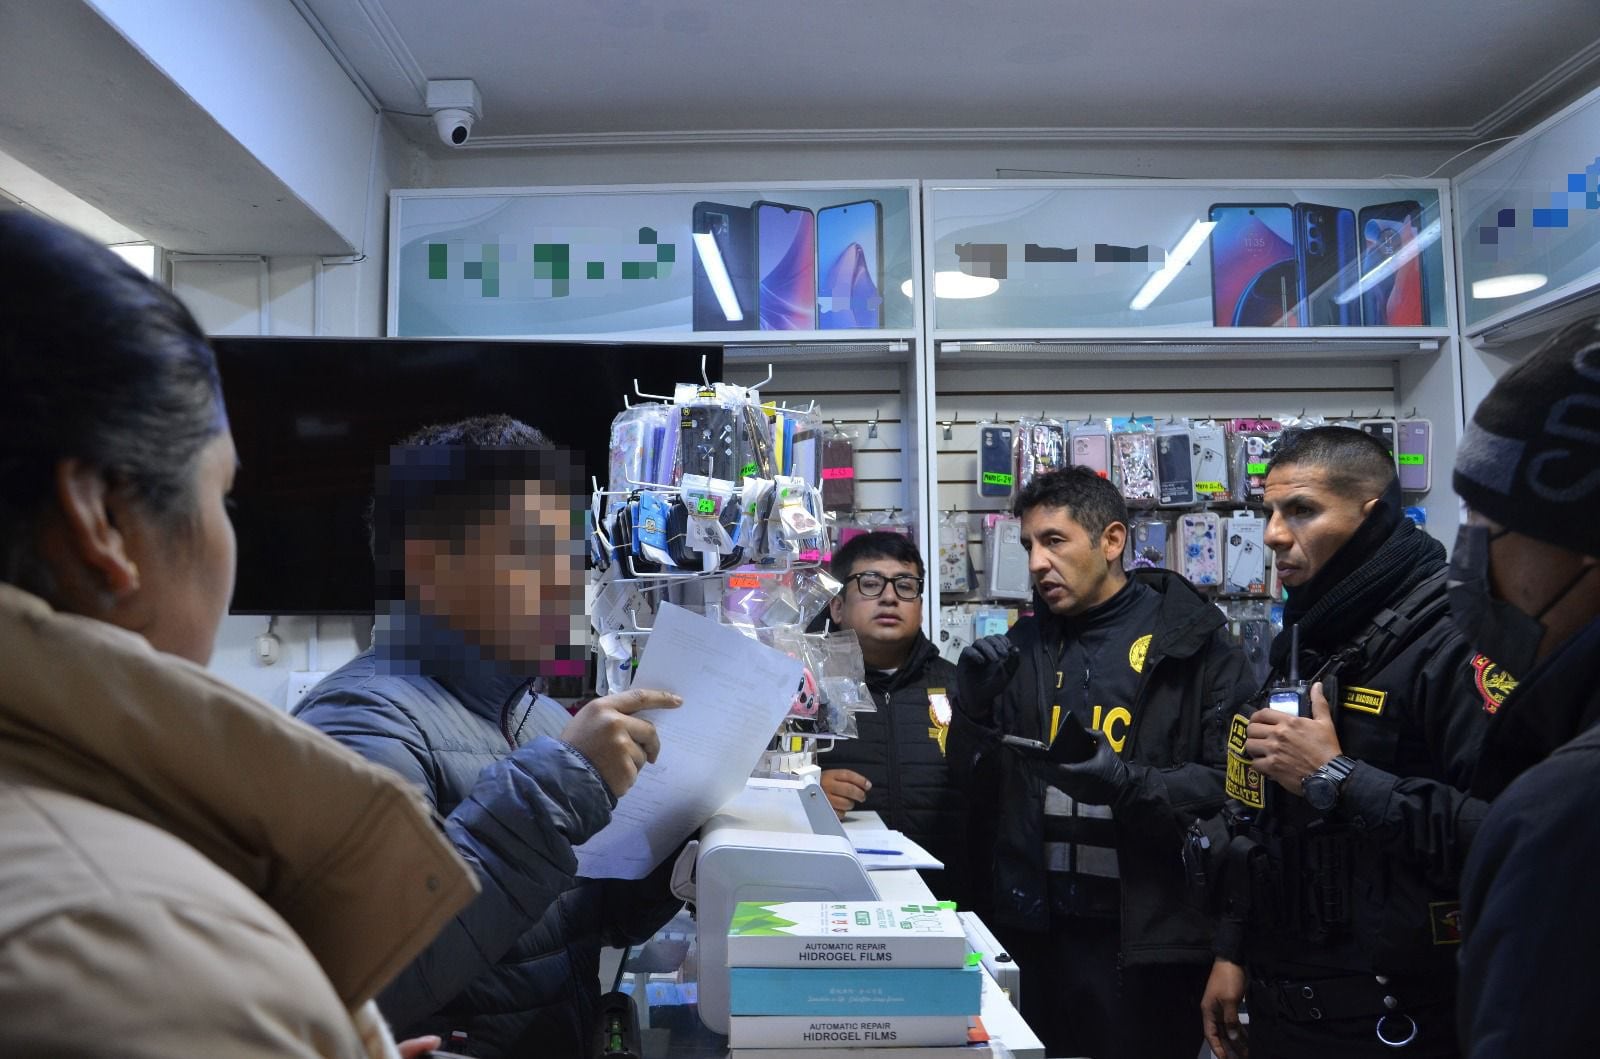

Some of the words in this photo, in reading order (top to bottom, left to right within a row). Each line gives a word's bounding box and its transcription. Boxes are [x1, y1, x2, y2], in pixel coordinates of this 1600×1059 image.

[799, 952, 856, 961] HIDROGEL
[860, 952, 892, 961] FILMS
[860, 1022, 891, 1030] REPAIR
[803, 1032, 861, 1041] HIDROGEL
[864, 1031, 897, 1040] FILMS
